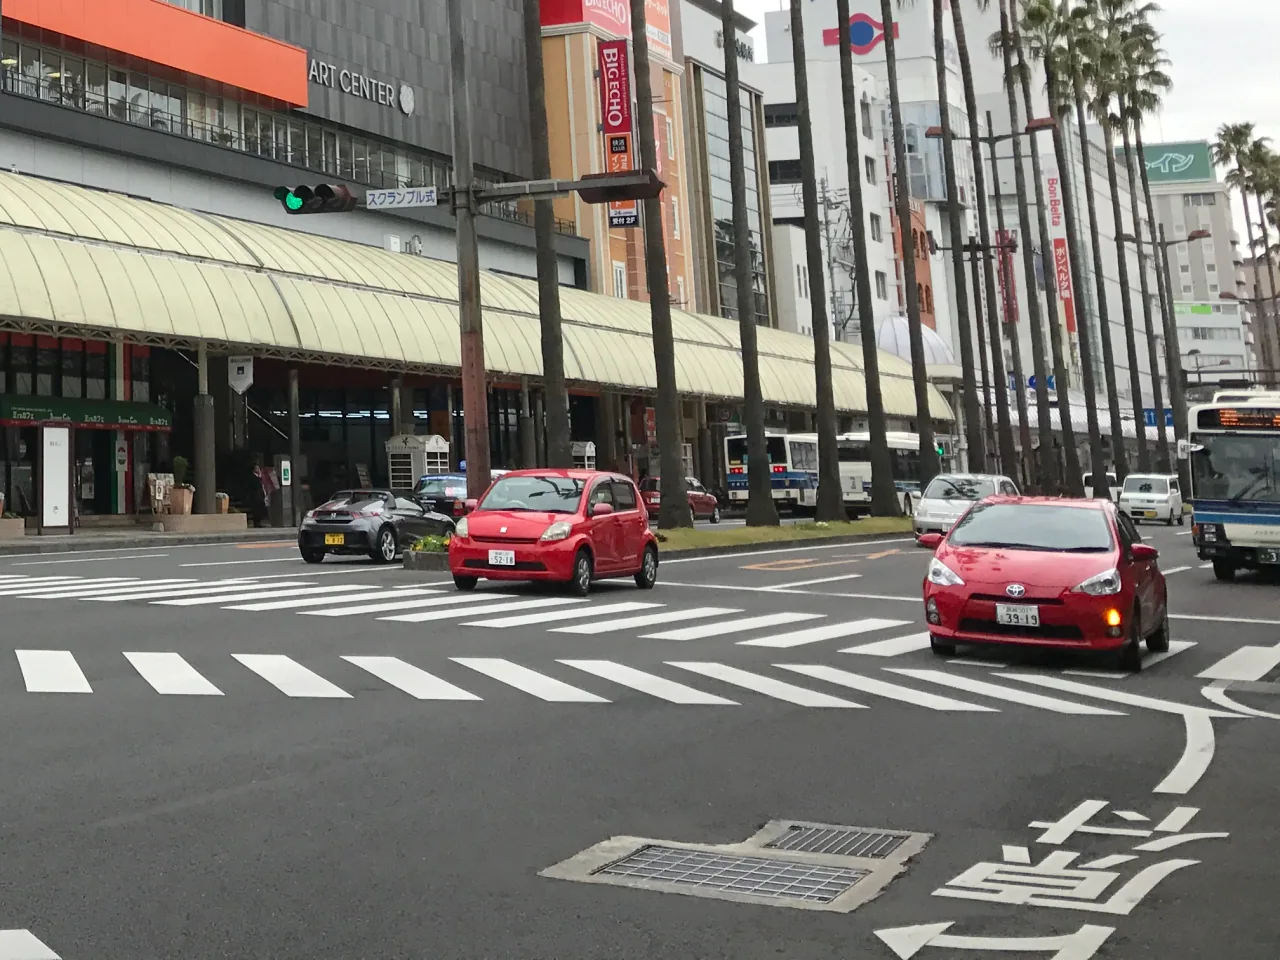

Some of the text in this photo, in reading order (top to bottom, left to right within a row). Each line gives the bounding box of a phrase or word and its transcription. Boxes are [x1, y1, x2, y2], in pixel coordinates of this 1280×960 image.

[309, 59, 395, 108] ART CENTER
[603, 48, 623, 127] BIG ECHO
[368, 190, 435, 206] スクランブル式
[1047, 177, 1062, 227] BonBelta
[1005, 613, 1038, 625] 39-19
[931, 799, 1230, 916] 原付
